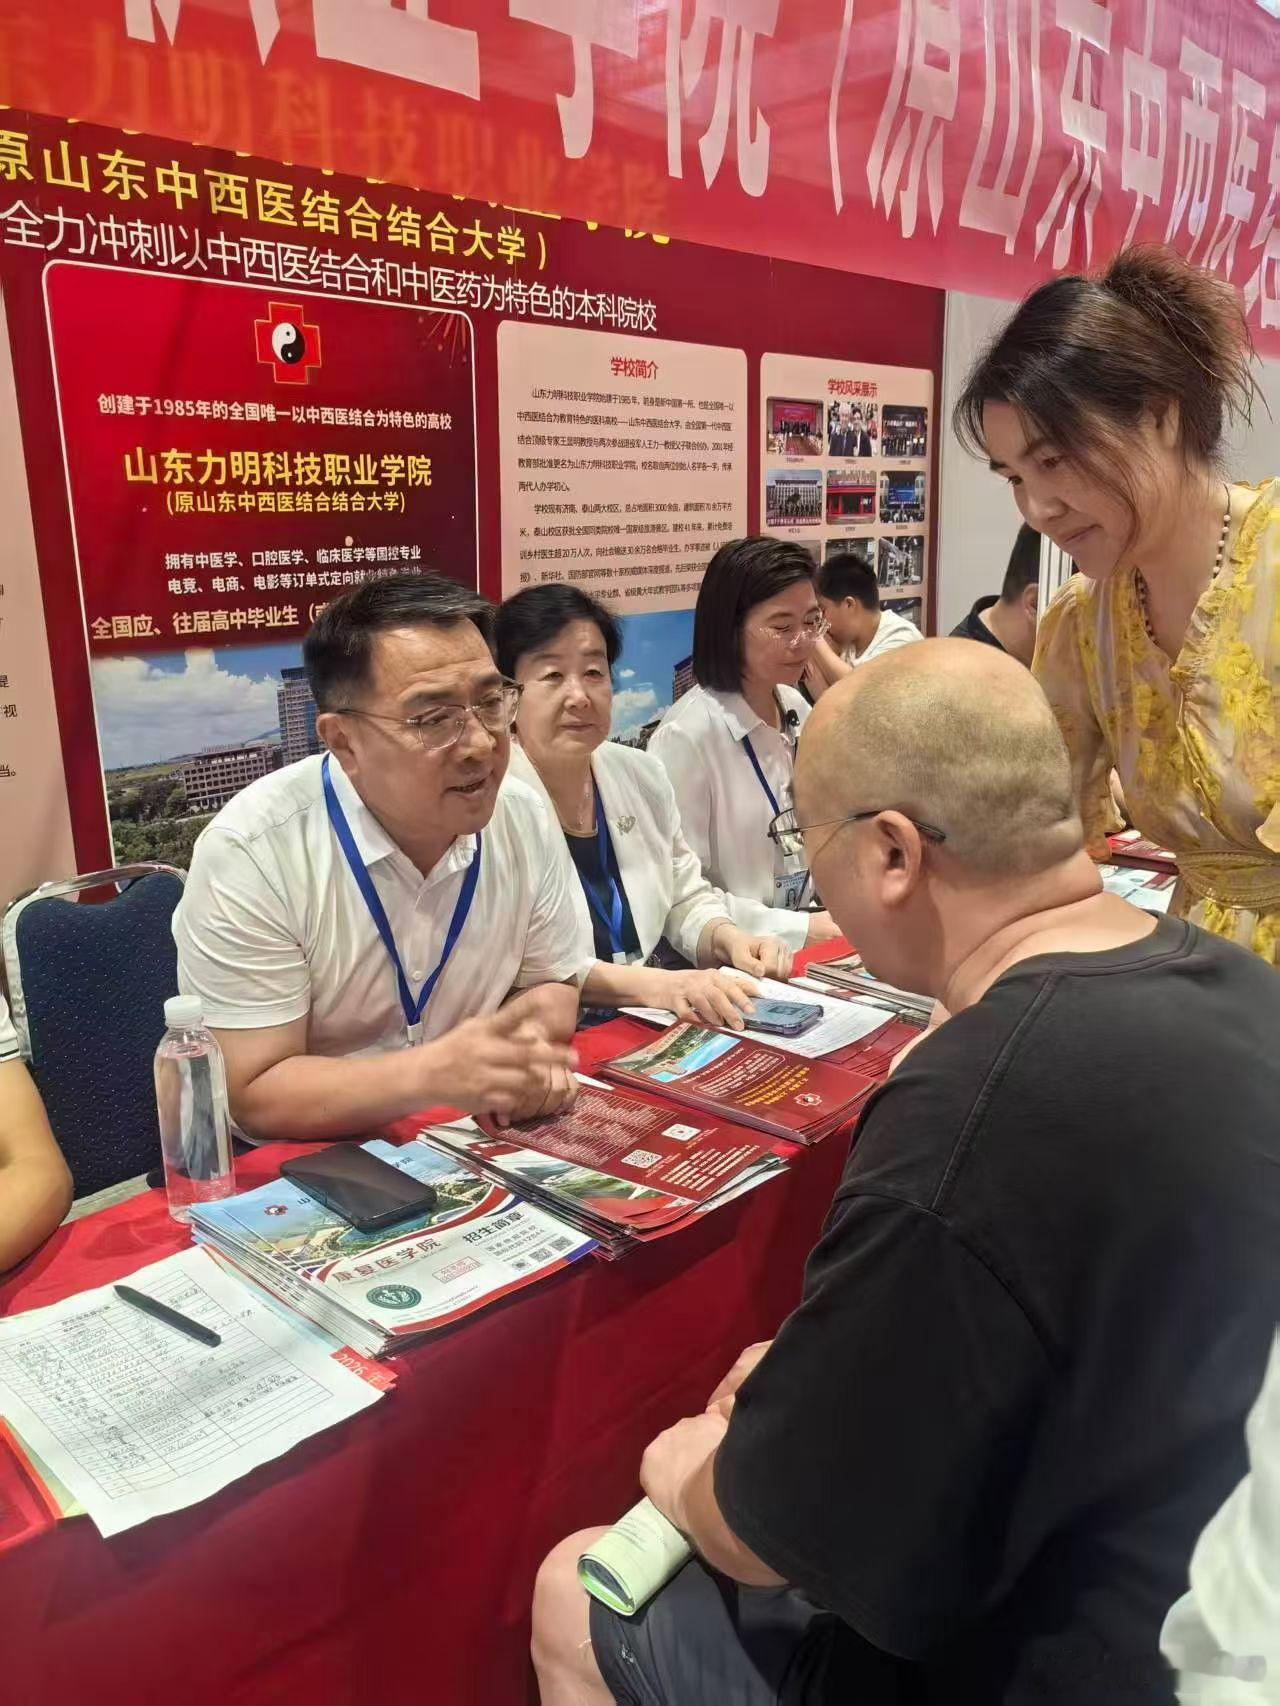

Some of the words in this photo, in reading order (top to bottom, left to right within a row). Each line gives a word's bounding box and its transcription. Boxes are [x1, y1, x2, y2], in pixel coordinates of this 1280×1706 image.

[0, 200, 657, 331] 全力冲刺以中西医结合和中医药为特色的本科院校
[610, 356, 660, 380] 学校简介
[828, 378, 878, 398] 学校风采展示
[97, 393, 452, 430] 创建于1985年的全国唯一以中西医结合为特色的高校
[124, 446, 432, 486] 山东力明科技职业学院
[166, 490, 405, 516] (原山东中西医结合结合大学)
[165, 545, 421, 570] 拥有中医学、口腔医学、临床医学等国控专业
[462, 1207, 525, 1244] 招生简章
[332, 1237, 441, 1283] 康复医学院
